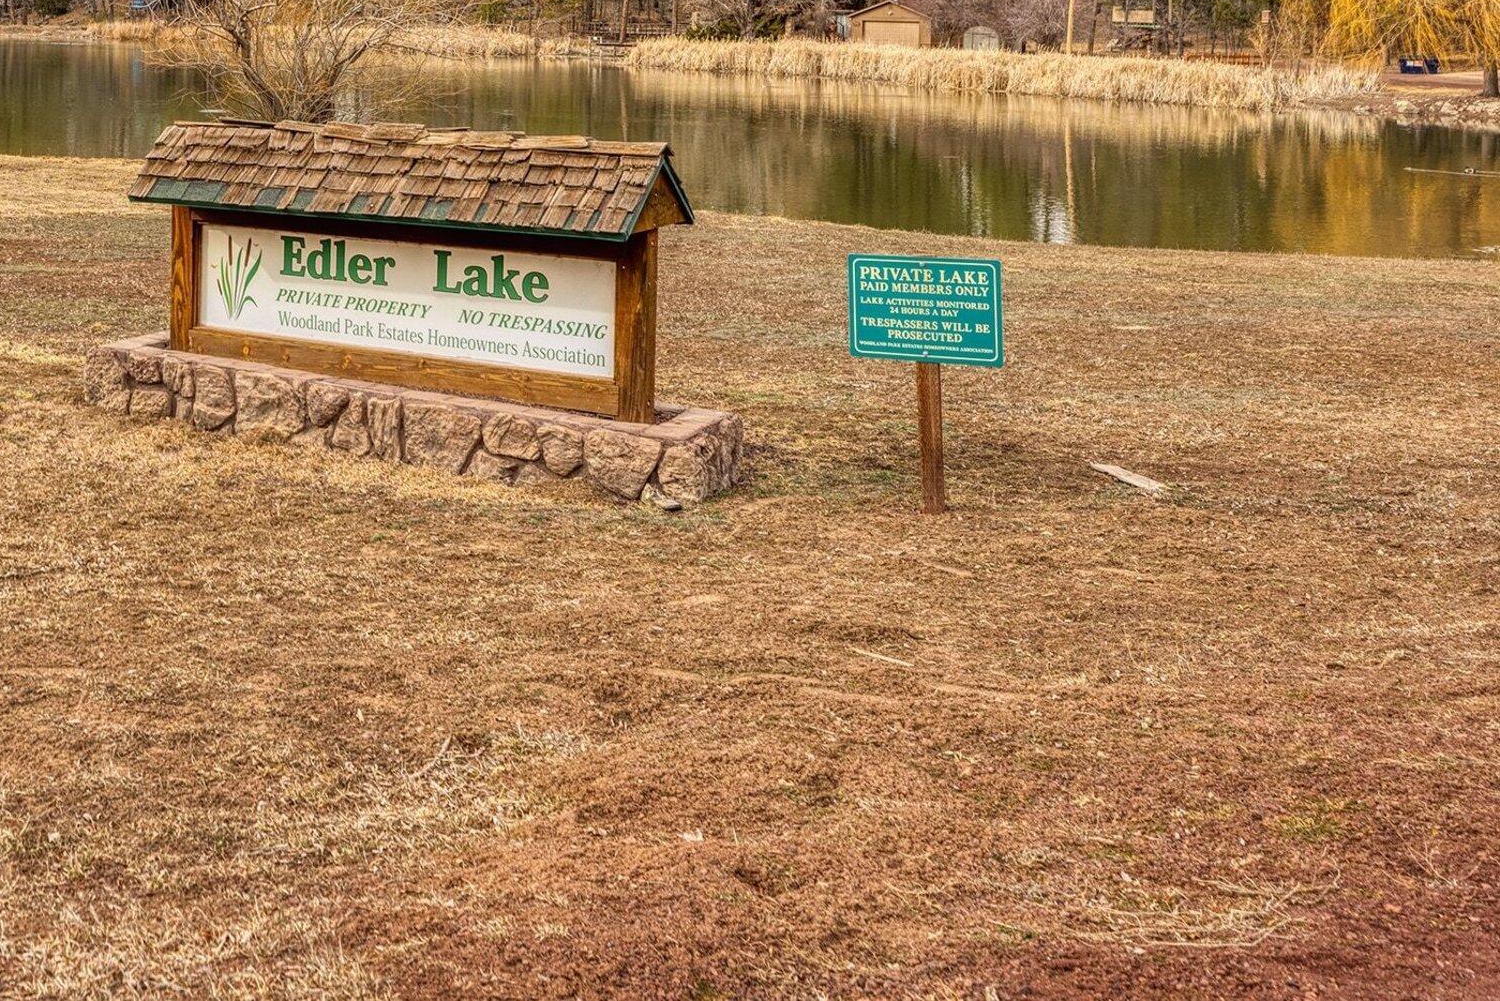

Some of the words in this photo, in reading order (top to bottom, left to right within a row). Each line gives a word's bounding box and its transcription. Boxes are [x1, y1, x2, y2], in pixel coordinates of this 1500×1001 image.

[280, 235, 396, 286] Edler
[433, 250, 549, 304] Lake
[860, 266, 933, 282] PRIVATE
[941, 270, 989, 285] LAKE
[860, 281, 888, 291] PAID
[892, 284, 952, 295] MEMBERS
[956, 286, 989, 297] ONLY
[276, 288, 343, 309] PRIVATE
[344, 296, 432, 319] PROPERTY
[886, 298, 933, 307] ACTIVITIES
[937, 301, 989, 310] MONITORED
[941, 309, 959, 317] DAY
[459, 309, 487, 324] NO
[488, 312, 608, 340] TRESPASSING
[861, 317, 938, 330] TRESPASSERS
[942, 322, 971, 332] WILL
[975, 324, 990, 333] BE
[278, 311, 341, 334] Woodland
[344, 319, 373, 337] Park
[378, 323, 424, 344] Estates
[428, 329, 518, 356] Homeowners
[522, 341, 606, 367] Association
[888, 331, 962, 343] PROSECUTED
